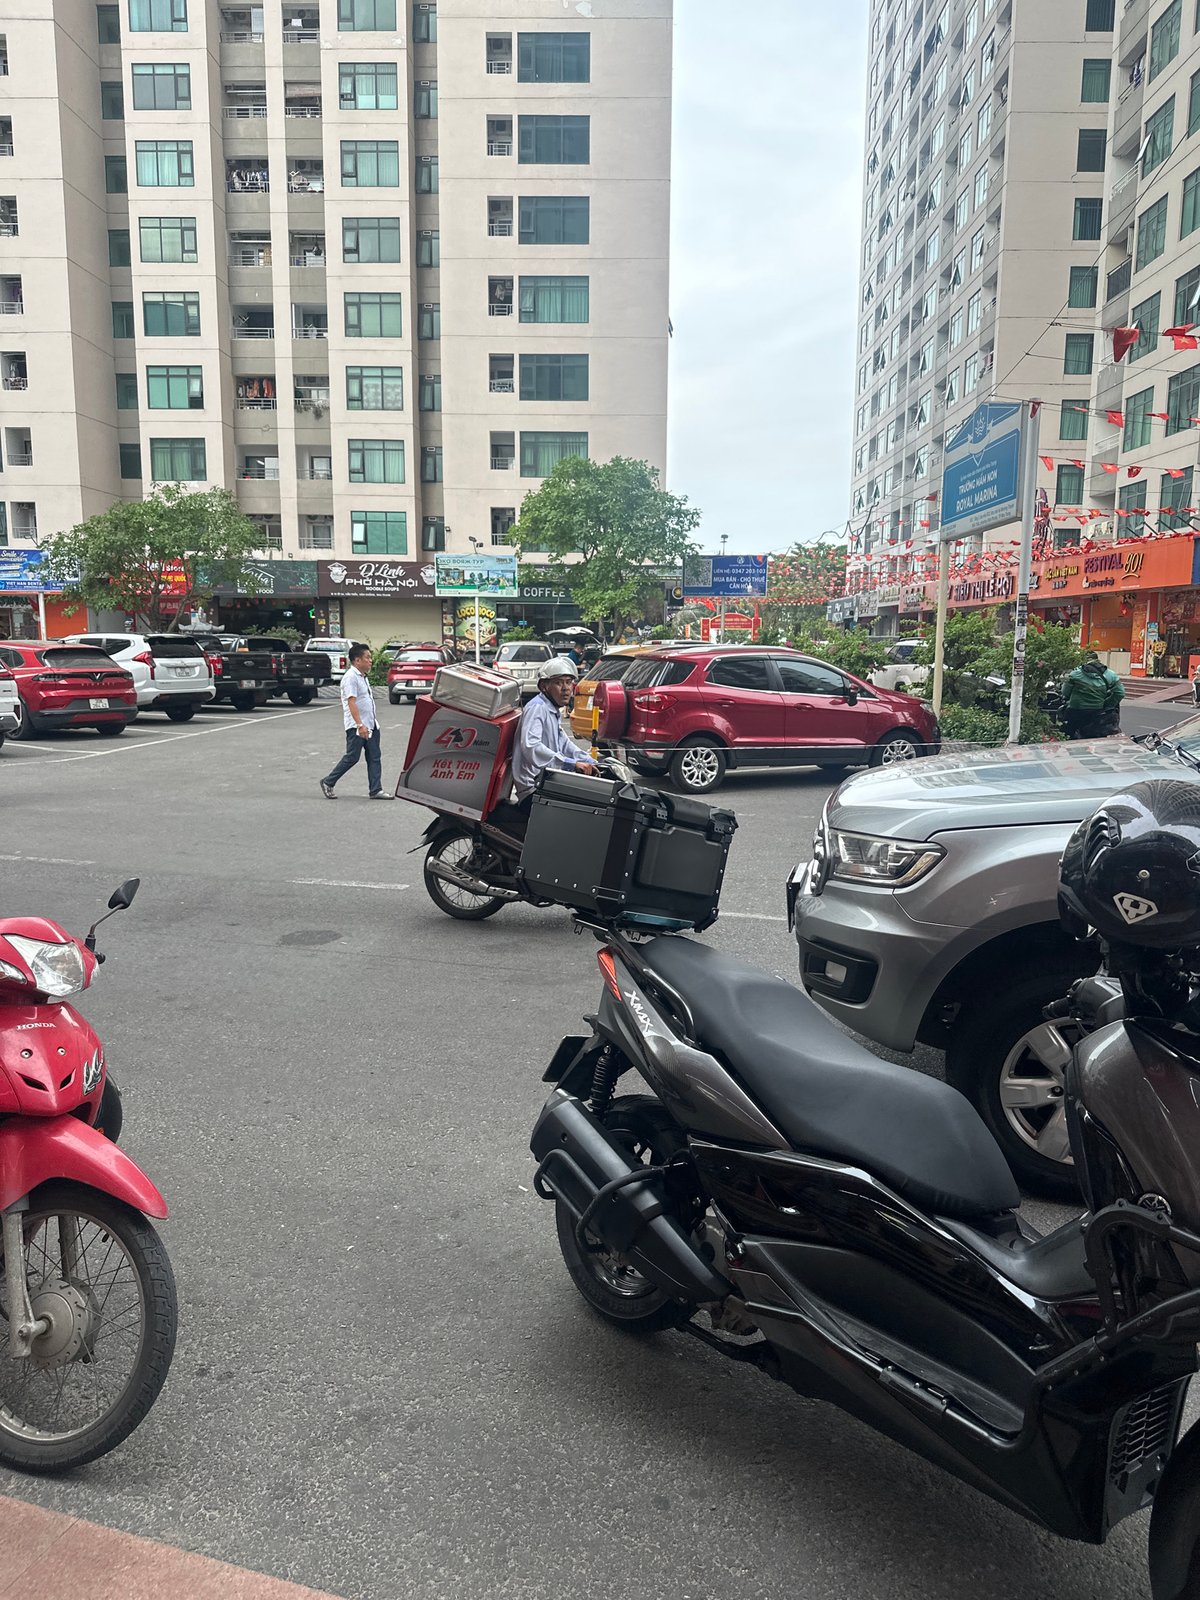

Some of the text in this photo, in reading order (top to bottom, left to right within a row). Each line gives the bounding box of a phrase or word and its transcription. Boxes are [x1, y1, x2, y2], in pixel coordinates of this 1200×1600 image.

[956, 484, 998, 512] ROYAL MARINA
[1084, 553, 1123, 573] FESTIVAL
[345, 577, 418, 588] PHỞ HÀ NỘI
[523, 587, 566, 597] COFFEE
[456, 606, 475, 619] LOCO
[430, 769, 476, 781] Anh Em
[624, 990, 653, 1033] XMAX
[16, 1022, 56, 1031] HONDA
